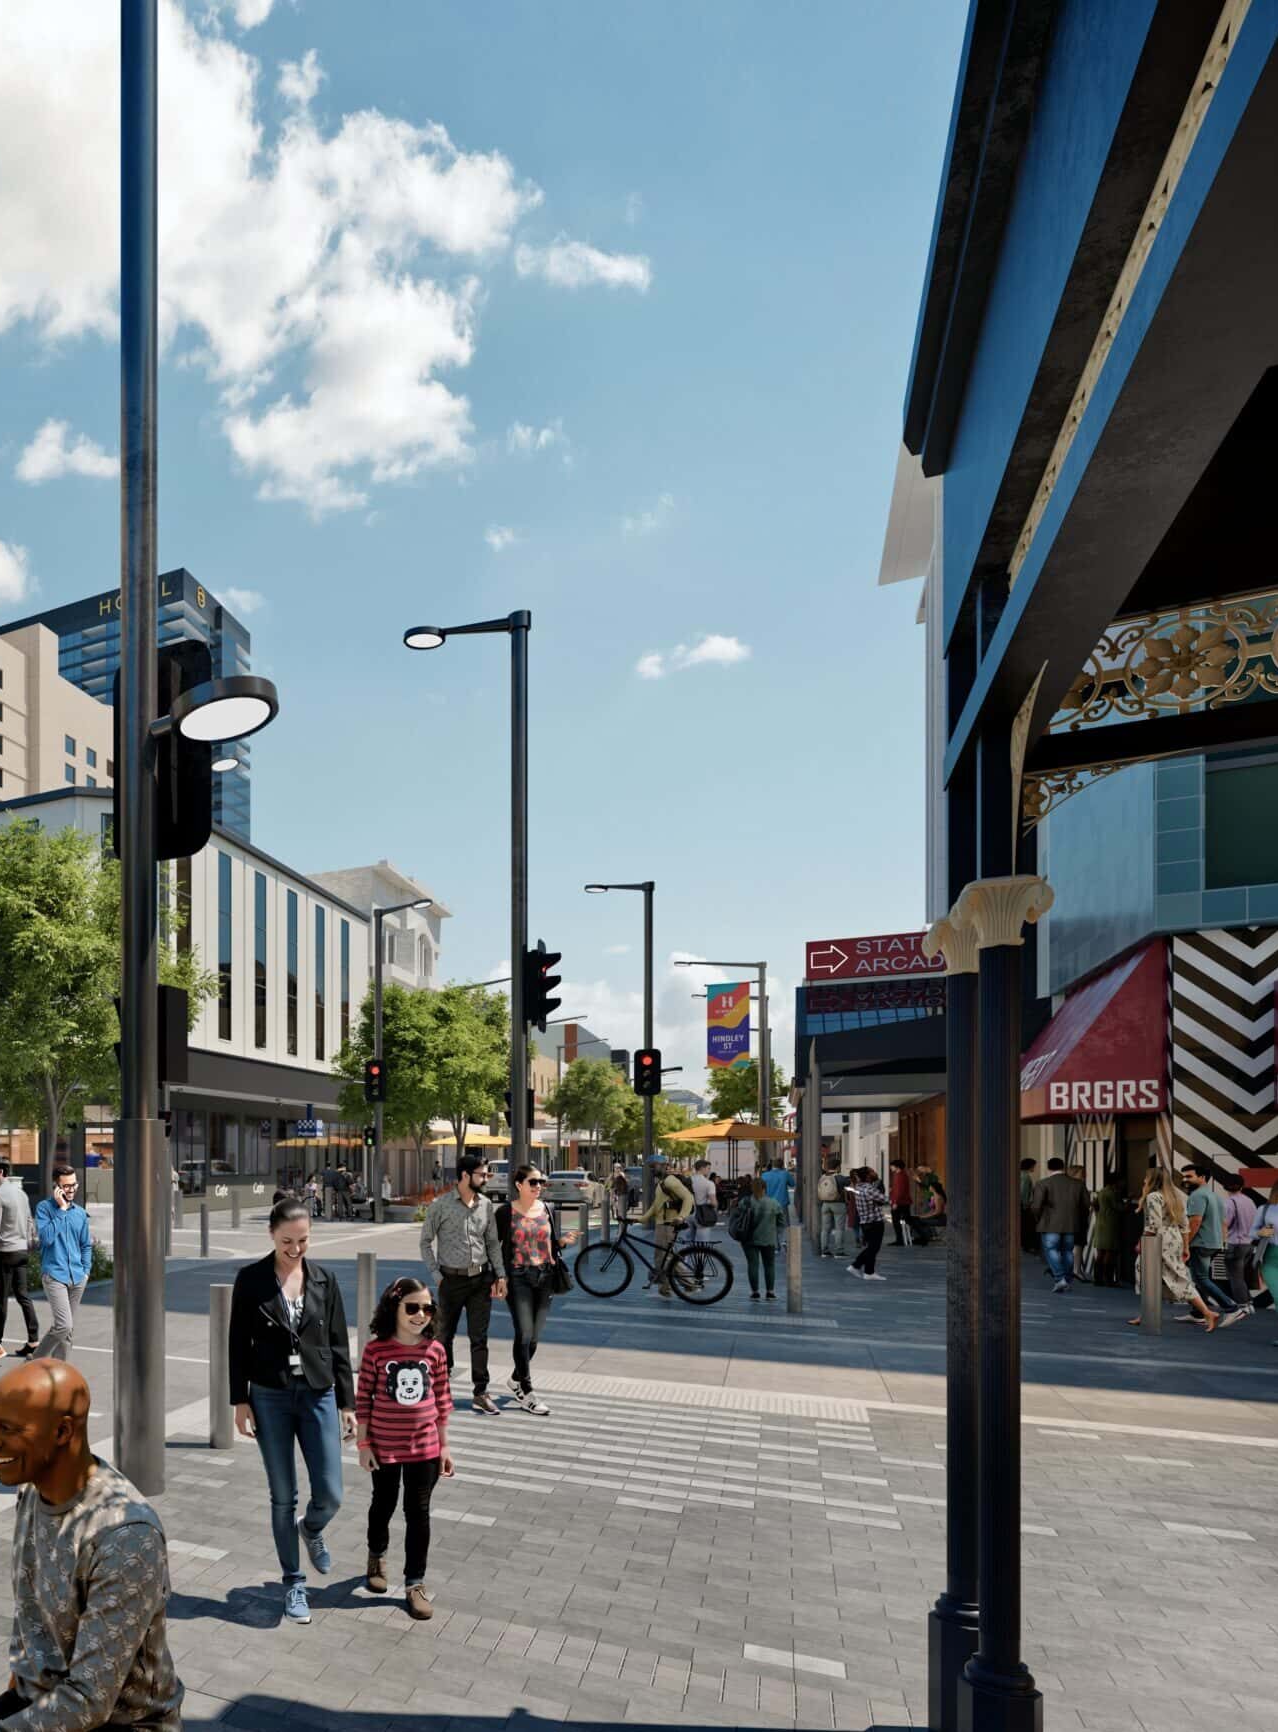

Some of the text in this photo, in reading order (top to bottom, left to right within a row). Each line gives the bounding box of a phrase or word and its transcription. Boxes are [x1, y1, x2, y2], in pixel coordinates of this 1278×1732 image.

[856, 935, 921, 955] STAT
[855, 953, 945, 974] ARCAD
[712, 1034, 744, 1044] HINDLEY
[723, 1042, 733, 1050] ST
[1049, 1079, 1160, 1111] BRGRS
